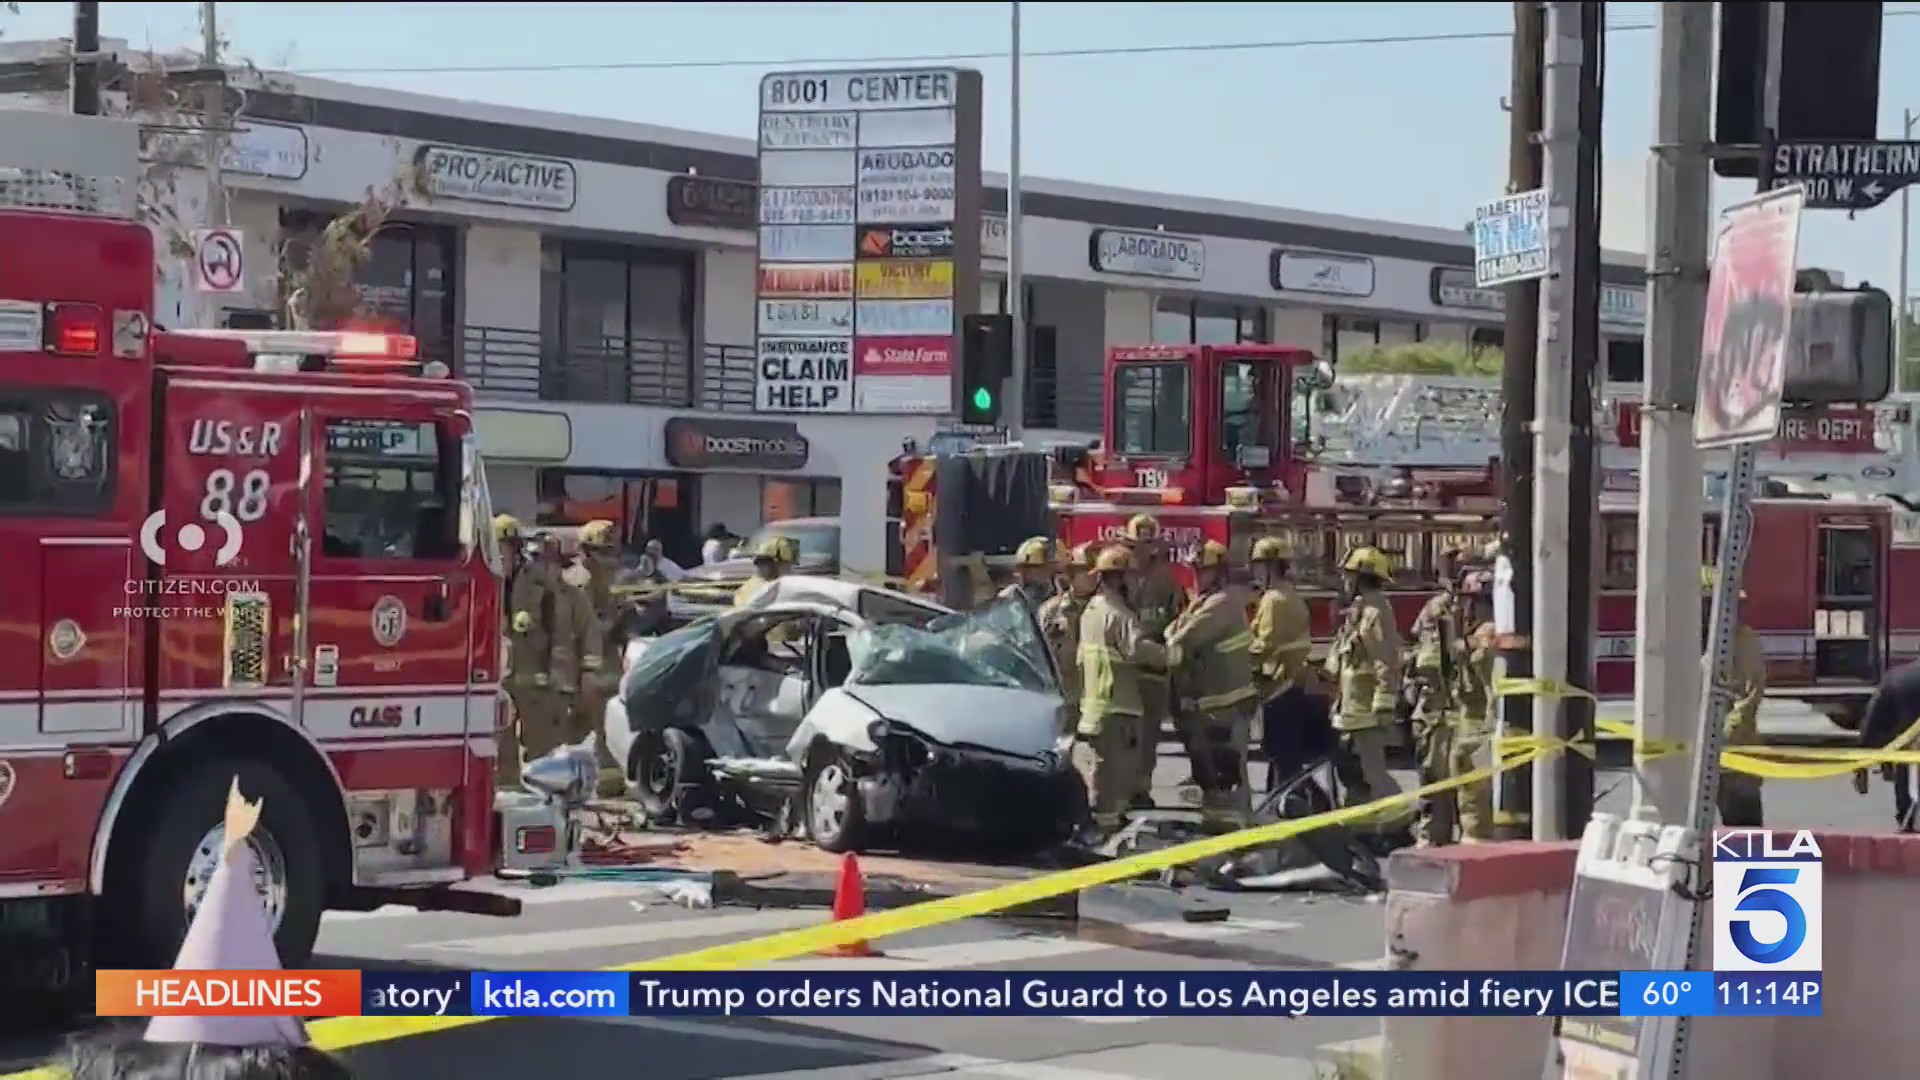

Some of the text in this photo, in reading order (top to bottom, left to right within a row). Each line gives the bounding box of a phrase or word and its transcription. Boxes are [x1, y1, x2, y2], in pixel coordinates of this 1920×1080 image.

[772, 73, 950, 104] 8001 CENTER
[1775, 144, 1920, 175] STRATHERN
[1119, 236, 1188, 262] ABOGADO
[761, 340, 849, 355] INSURANCE
[883, 347, 948, 363] State Farm
[762, 357, 849, 382] CLAIM
[767, 385, 839, 408] HELP
[200, 468, 271, 522] 88
[414, 706, 422, 727] 1
